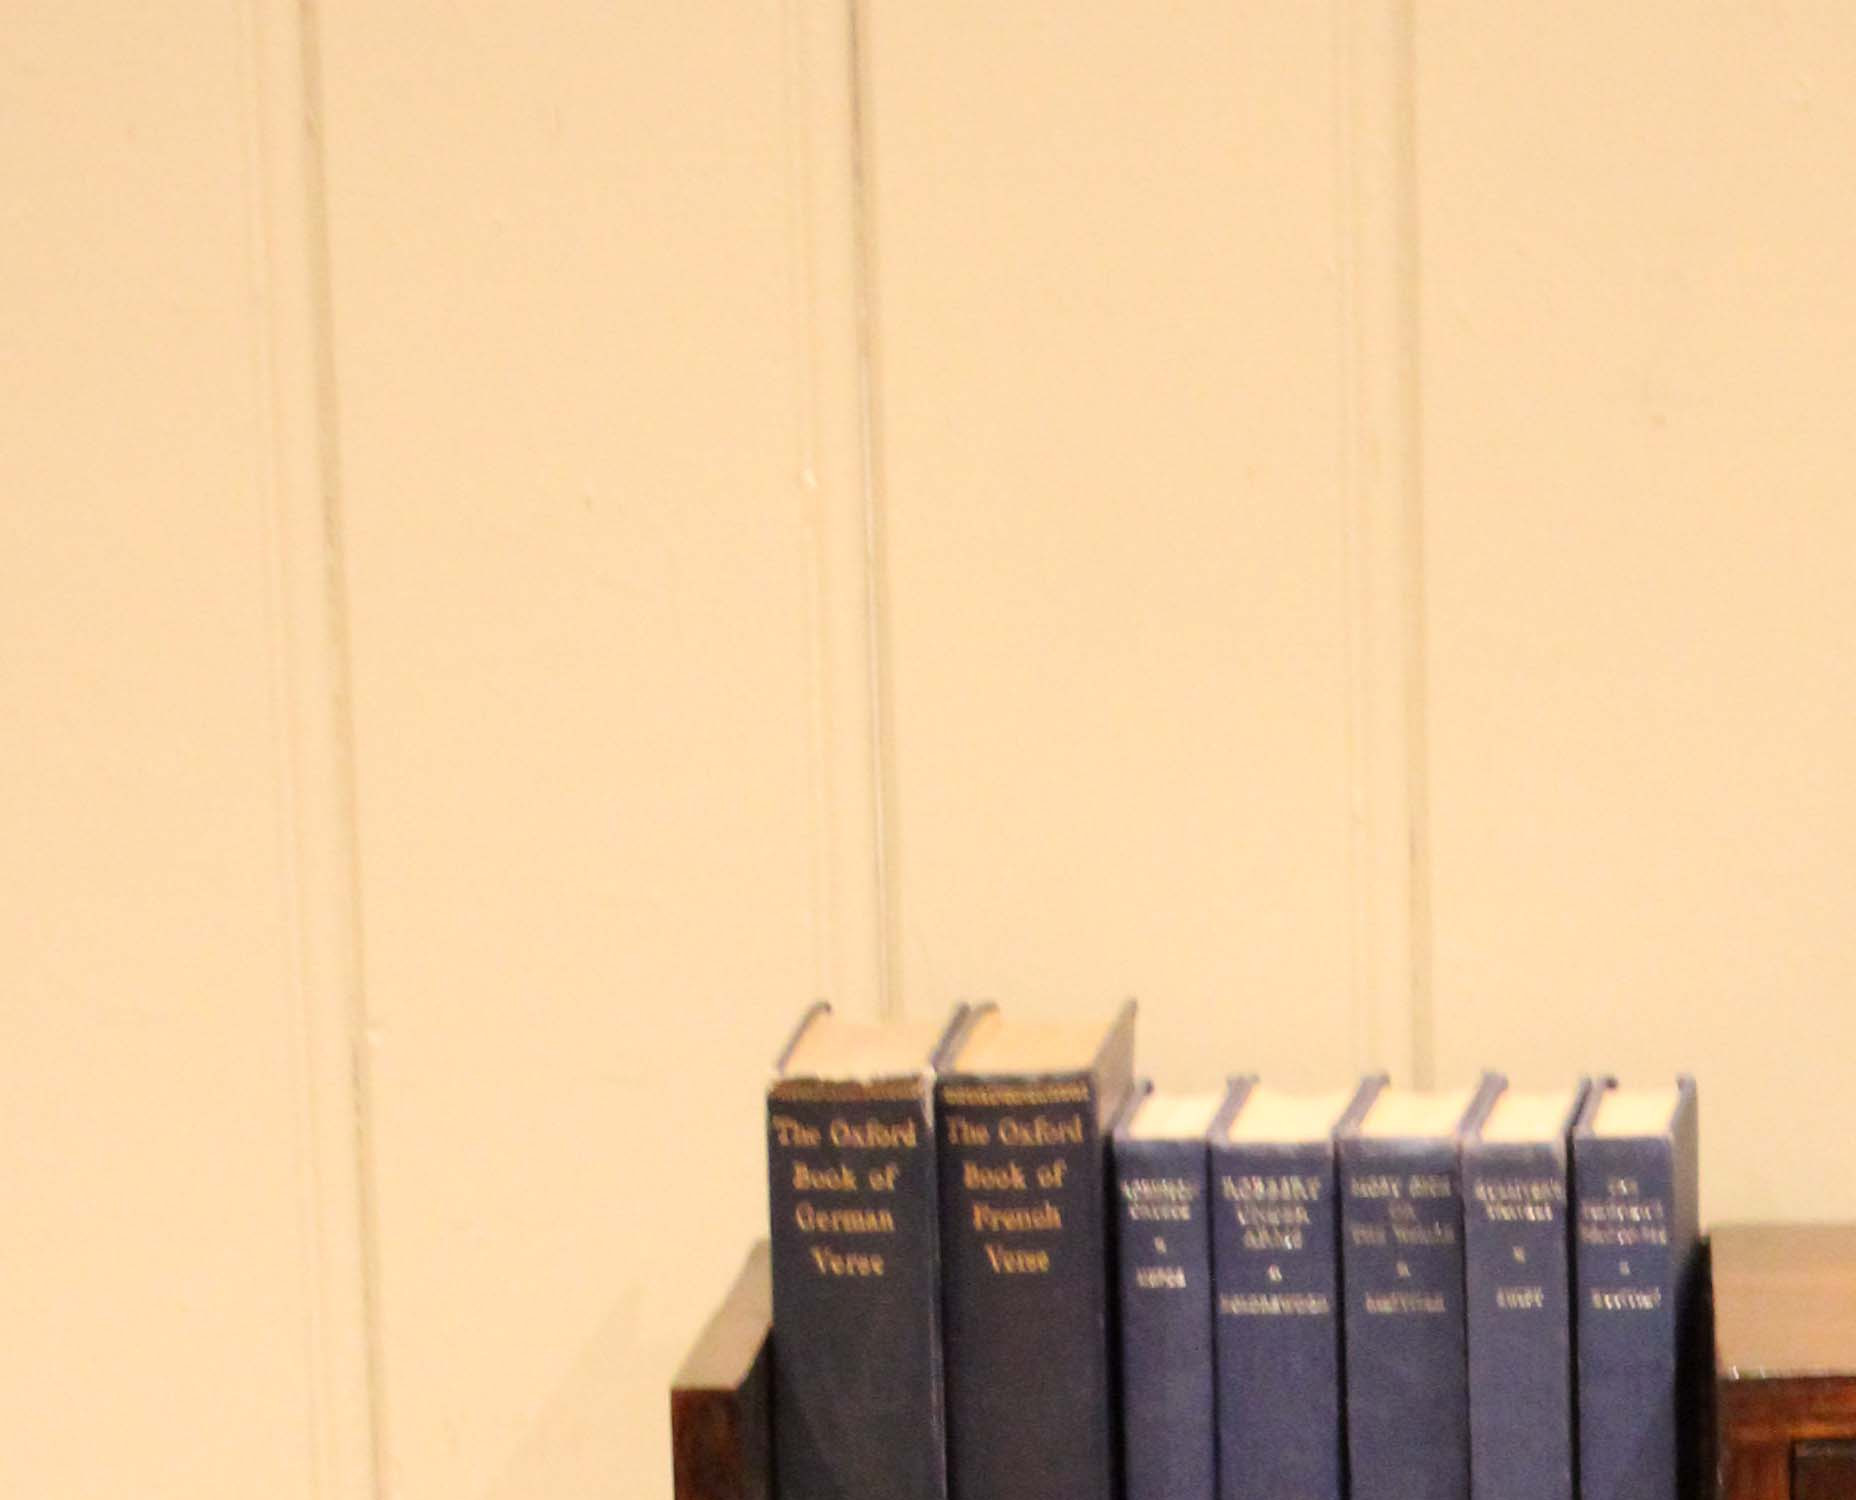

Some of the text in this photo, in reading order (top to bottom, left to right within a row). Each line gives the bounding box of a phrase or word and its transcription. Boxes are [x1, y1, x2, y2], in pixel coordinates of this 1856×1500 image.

[773, 1116, 917, 1148] The Oxford
[946, 1114, 1083, 1145] The Oxford
[793, 1161, 898, 1191] Book of
[963, 1160, 1067, 1190] Book of
[796, 1204, 894, 1232] German
[812, 1245, 885, 1276] Verse
